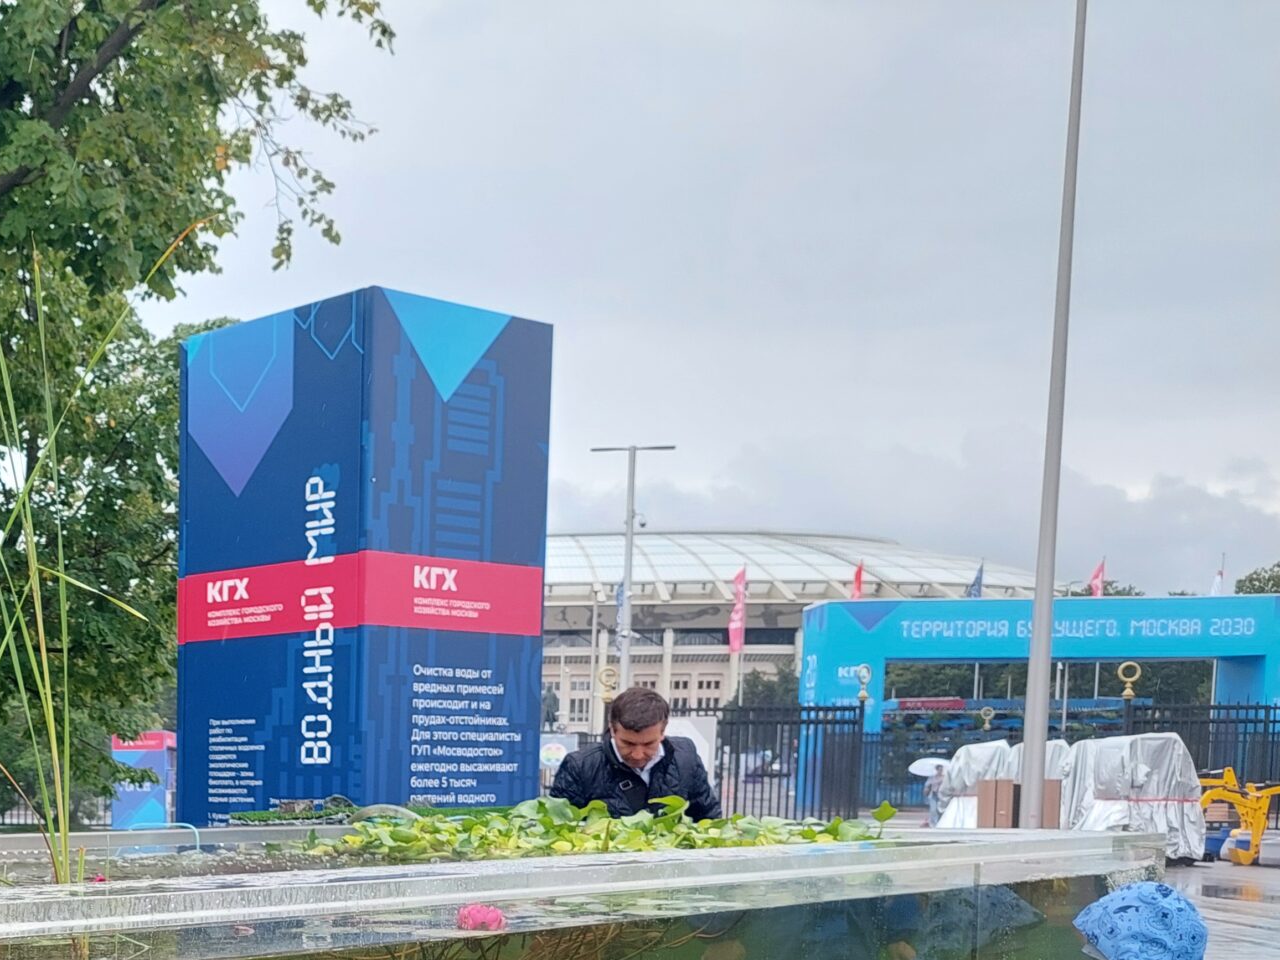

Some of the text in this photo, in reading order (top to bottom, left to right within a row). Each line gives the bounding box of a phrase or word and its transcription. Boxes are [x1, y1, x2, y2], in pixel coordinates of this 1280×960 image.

[413, 565, 458, 592] КГХ
[207, 577, 250, 604] КГХ
[449, 599, 491, 610] ГОРОДСКОГО
[300, 476, 336, 764] ВОДНЫЙ МИР
[901, 617, 1255, 639] ТЕРРИТОРИЯ БУЩЕГО. МОСКВА 2030
[413, 664, 492, 679] Очистка воды от
[412, 682, 504, 696] вредных примесей
[412, 698, 491, 710] происходит и на
[412, 714, 509, 727] прудах-отстойниках.
[411, 728, 522, 742] Для этого специалисты
[411, 744, 503, 757] ГУП «Мосводосток»
[410, 762, 518, 773] ежегодно высаживают
[410, 776, 477, 788] более 5 тысяч
[457, 792, 496, 803] водного
